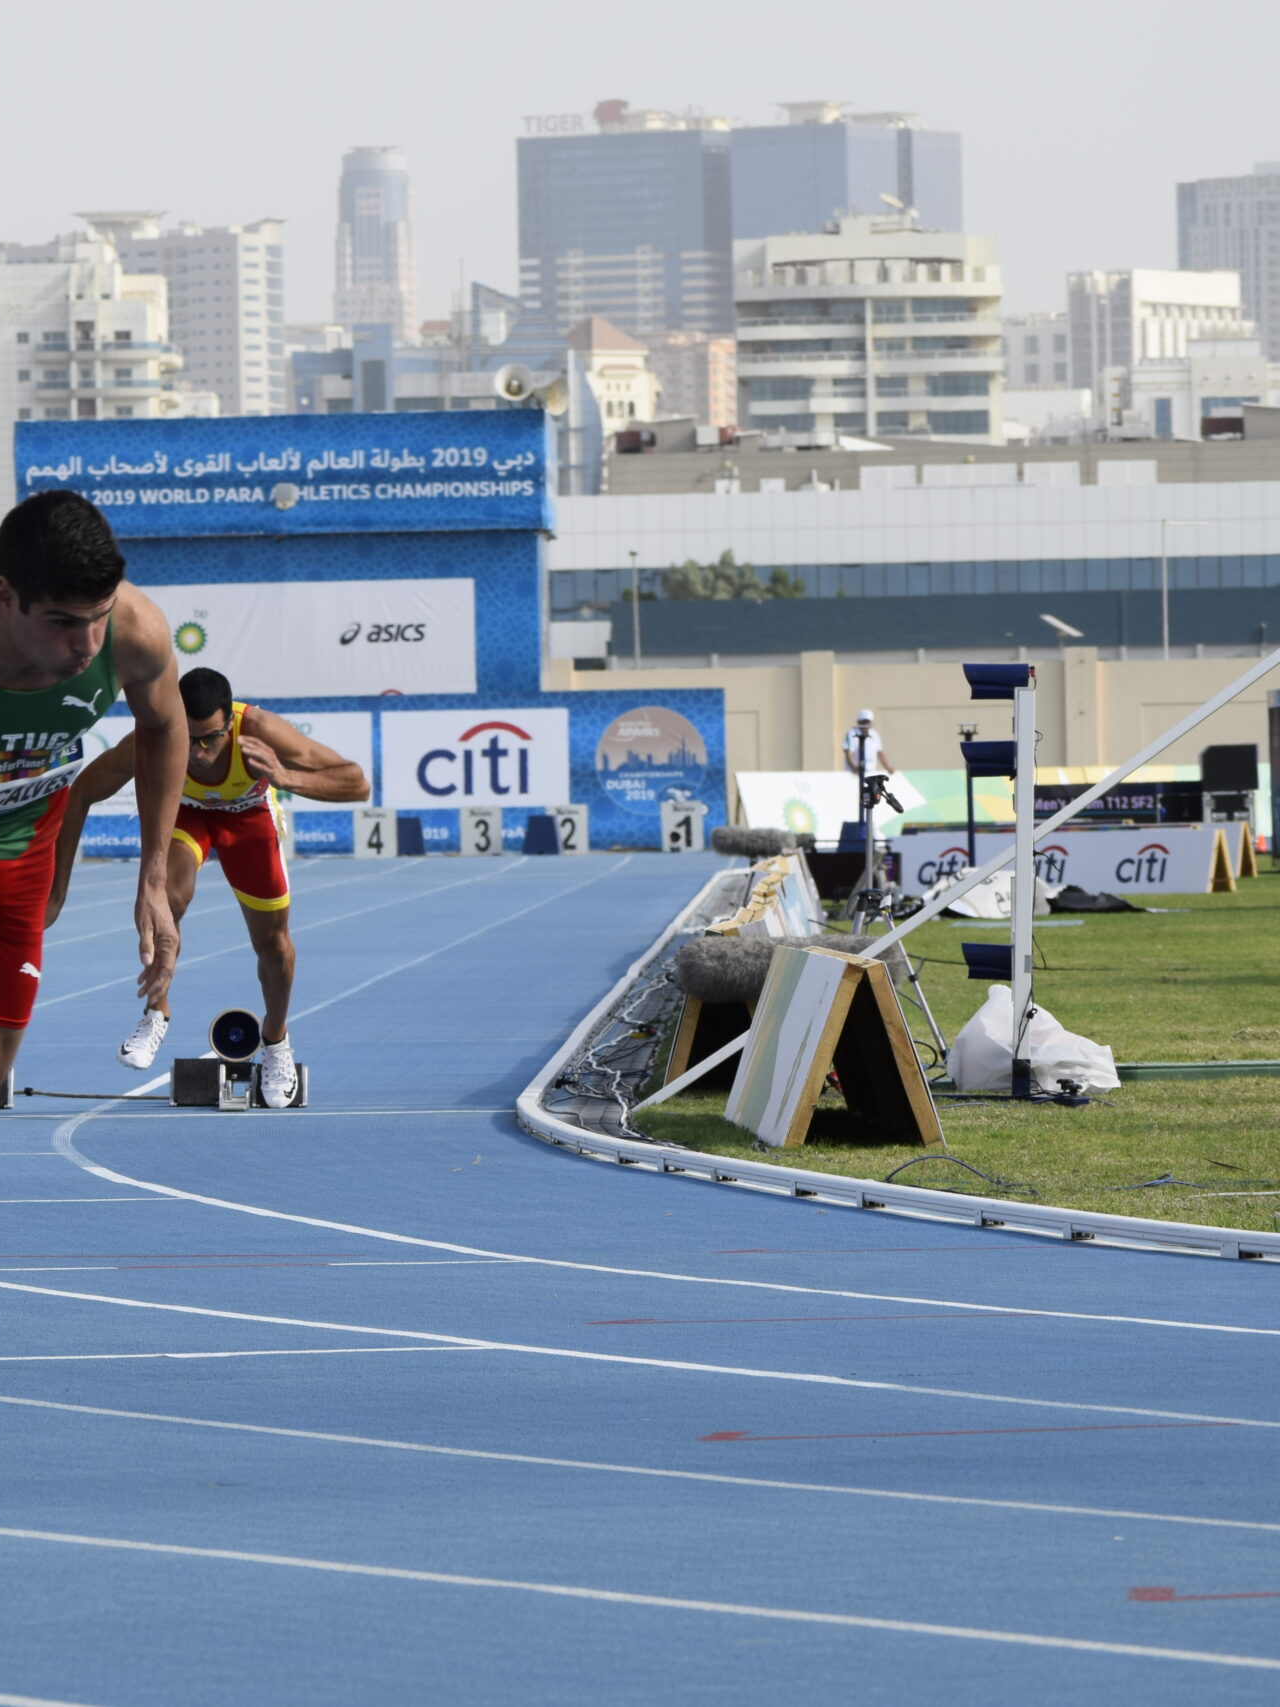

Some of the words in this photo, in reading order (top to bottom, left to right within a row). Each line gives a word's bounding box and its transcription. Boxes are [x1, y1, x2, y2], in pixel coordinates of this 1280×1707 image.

[521, 113, 585, 134] TIGER
[25, 455, 82, 487] الهمم
[87, 450, 168, 482] لأصحاب
[173, 453, 231, 478] القوى
[237, 447, 302, 479] لألعاب
[307, 450, 365, 480] العالم
[369, 447, 426, 473] بطولة
[431, 447, 488, 468] 2019
[493, 450, 536, 477] دبي
[93, 489, 136, 506] 2019
[140, 487, 210, 505] WORLD
[214, 486, 265, 503] PARA
[268, 483, 371, 501] HLETICS
[375, 480, 535, 499] CHAMPIONSHIPS
[193, 608, 209, 620] bp
[366, 623, 427, 643] asics
[416, 735, 530, 797] citi
[367, 821, 384, 855] 4
[474, 818, 492, 852] 3
[560, 817, 578, 850] 2
[676, 815, 693, 847] 1
[1115, 850, 1168, 883] citi
